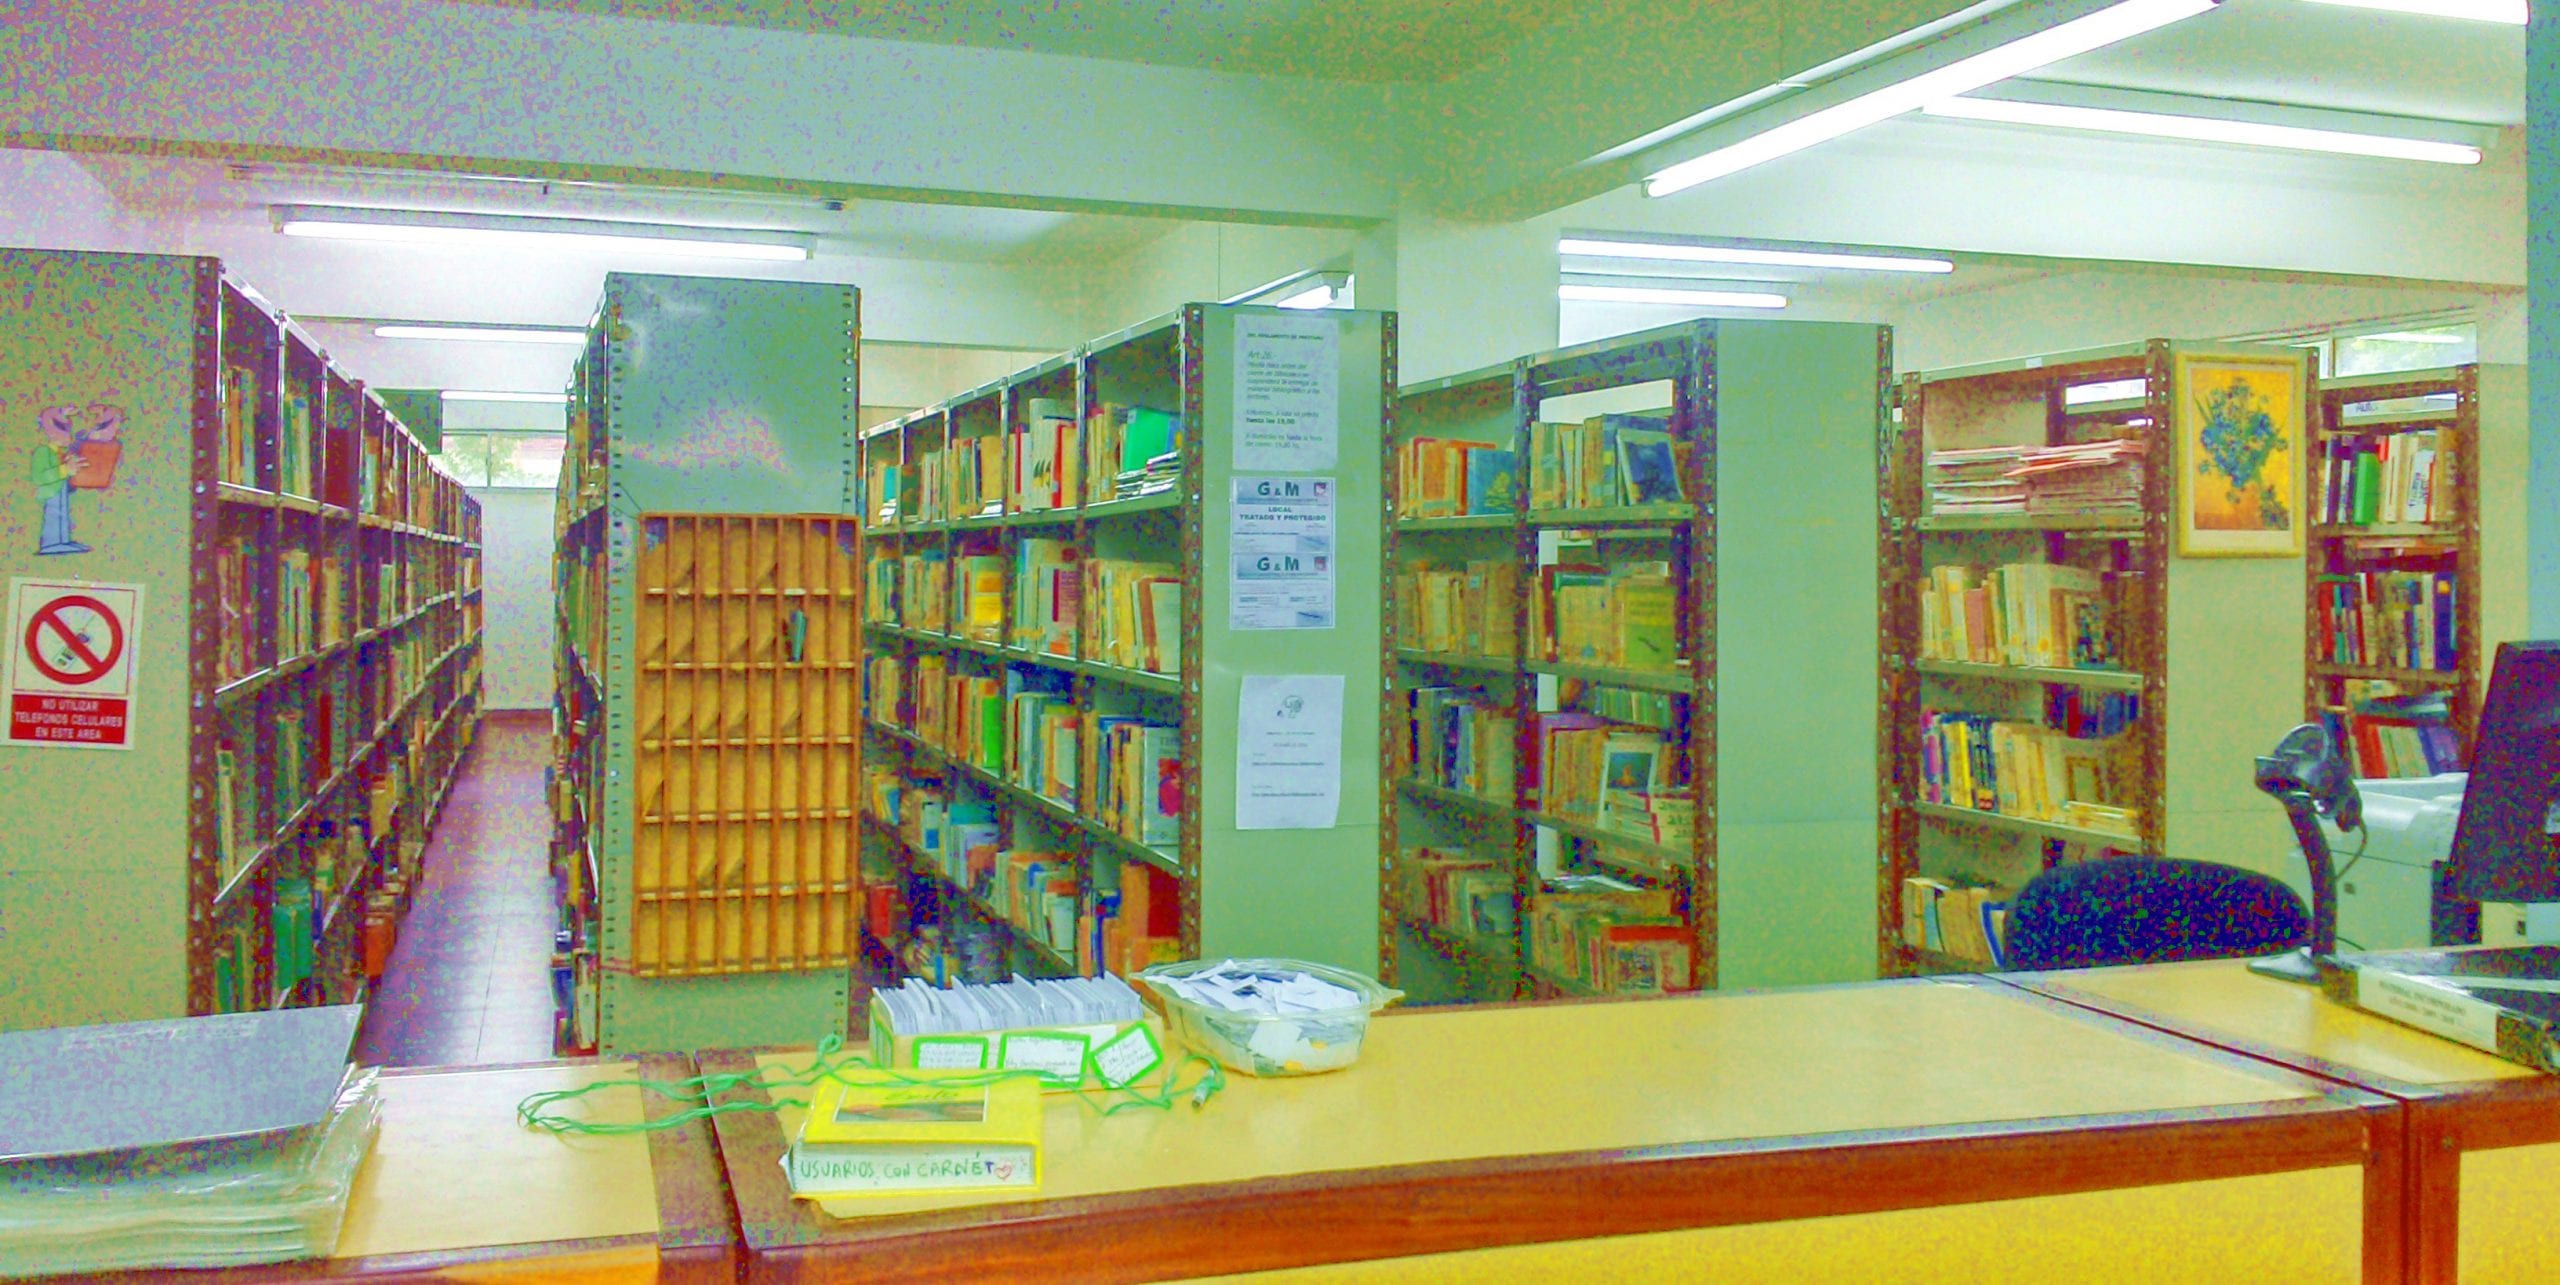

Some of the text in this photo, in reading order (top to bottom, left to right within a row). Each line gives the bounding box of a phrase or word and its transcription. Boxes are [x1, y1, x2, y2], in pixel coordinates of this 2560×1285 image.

[1257, 481, 1300, 497] G & M
[1283, 514, 1327, 522] PROTEGIDO
[1256, 556, 1300, 572] G & M
[42, 699, 98, 712] NO UTILIZAR
[15, 711, 123, 727] TELEFONOS CELULARES
[35, 727, 101, 739] EN ESTE AREA
[799, 1160, 875, 1179] USUARIOS
